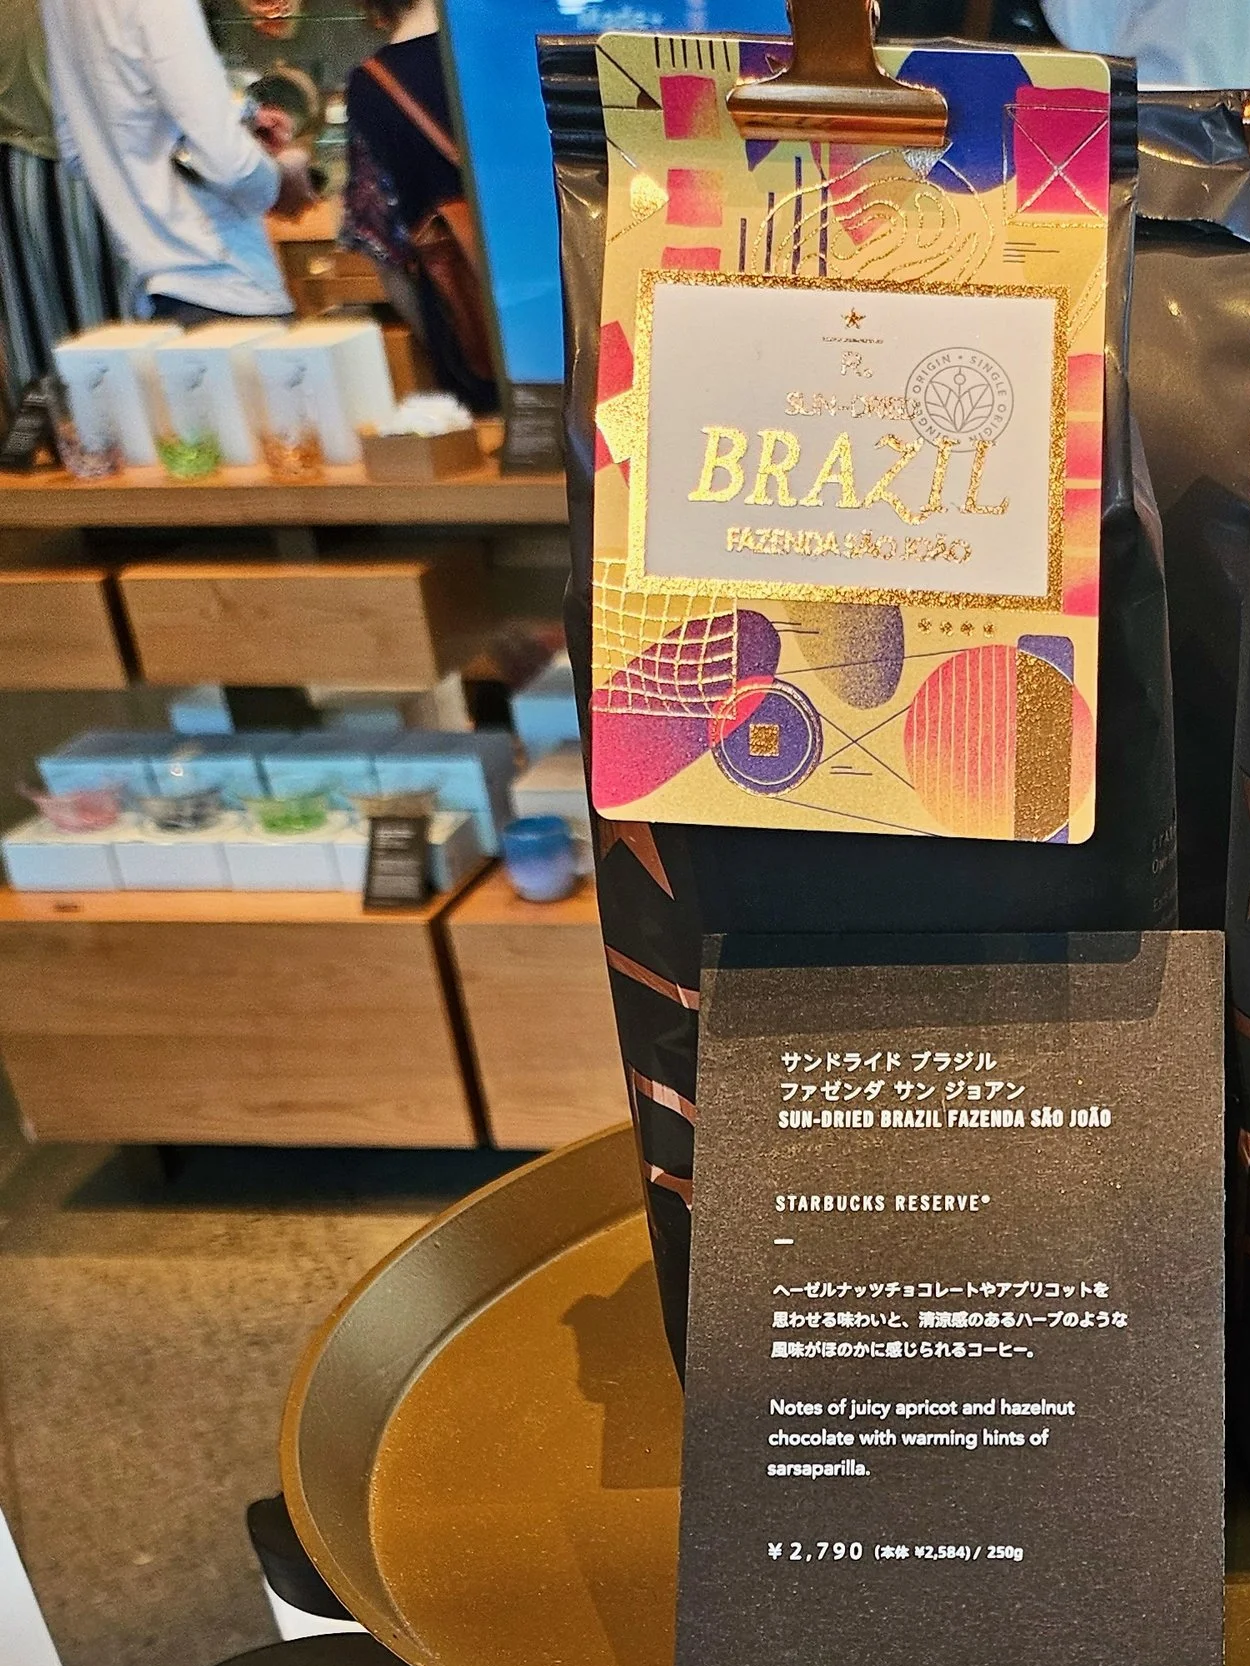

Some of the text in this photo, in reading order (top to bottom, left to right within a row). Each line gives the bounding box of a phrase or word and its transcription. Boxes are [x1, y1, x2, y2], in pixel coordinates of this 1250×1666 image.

[912, 354, 952, 394] ORIGIN
[969, 355, 1007, 396] SINGLE
[688, 425, 1010, 526] BRAZIL
[726, 527, 974, 564] FAZENDA SÃO JOÃO
[780, 1051, 998, 1073] サンドライド ブラジル
[780, 1079, 1026, 1102] ファゼンダ サン ジョアン
[778, 1106, 1112, 1129] SUN-DRIED BRAZIL FAZENDA SÃO JOÃO
[775, 1195, 886, 1213] STARBUCKS
[772, 1280, 1110, 1299] ヘーゼルナッツチョコレートやアプリコットを
[770, 1341, 1035, 1359] 風味がほのかに感じられるコーヒー。
[769, 1398, 1076, 1421] Notes of juicy apricot and hazelnut
[768, 1428, 1050, 1450] chocolate with warming hints of
[767, 1458, 871, 1480] sarsaparilla.
[986, 1545, 1024, 1562] 250g
